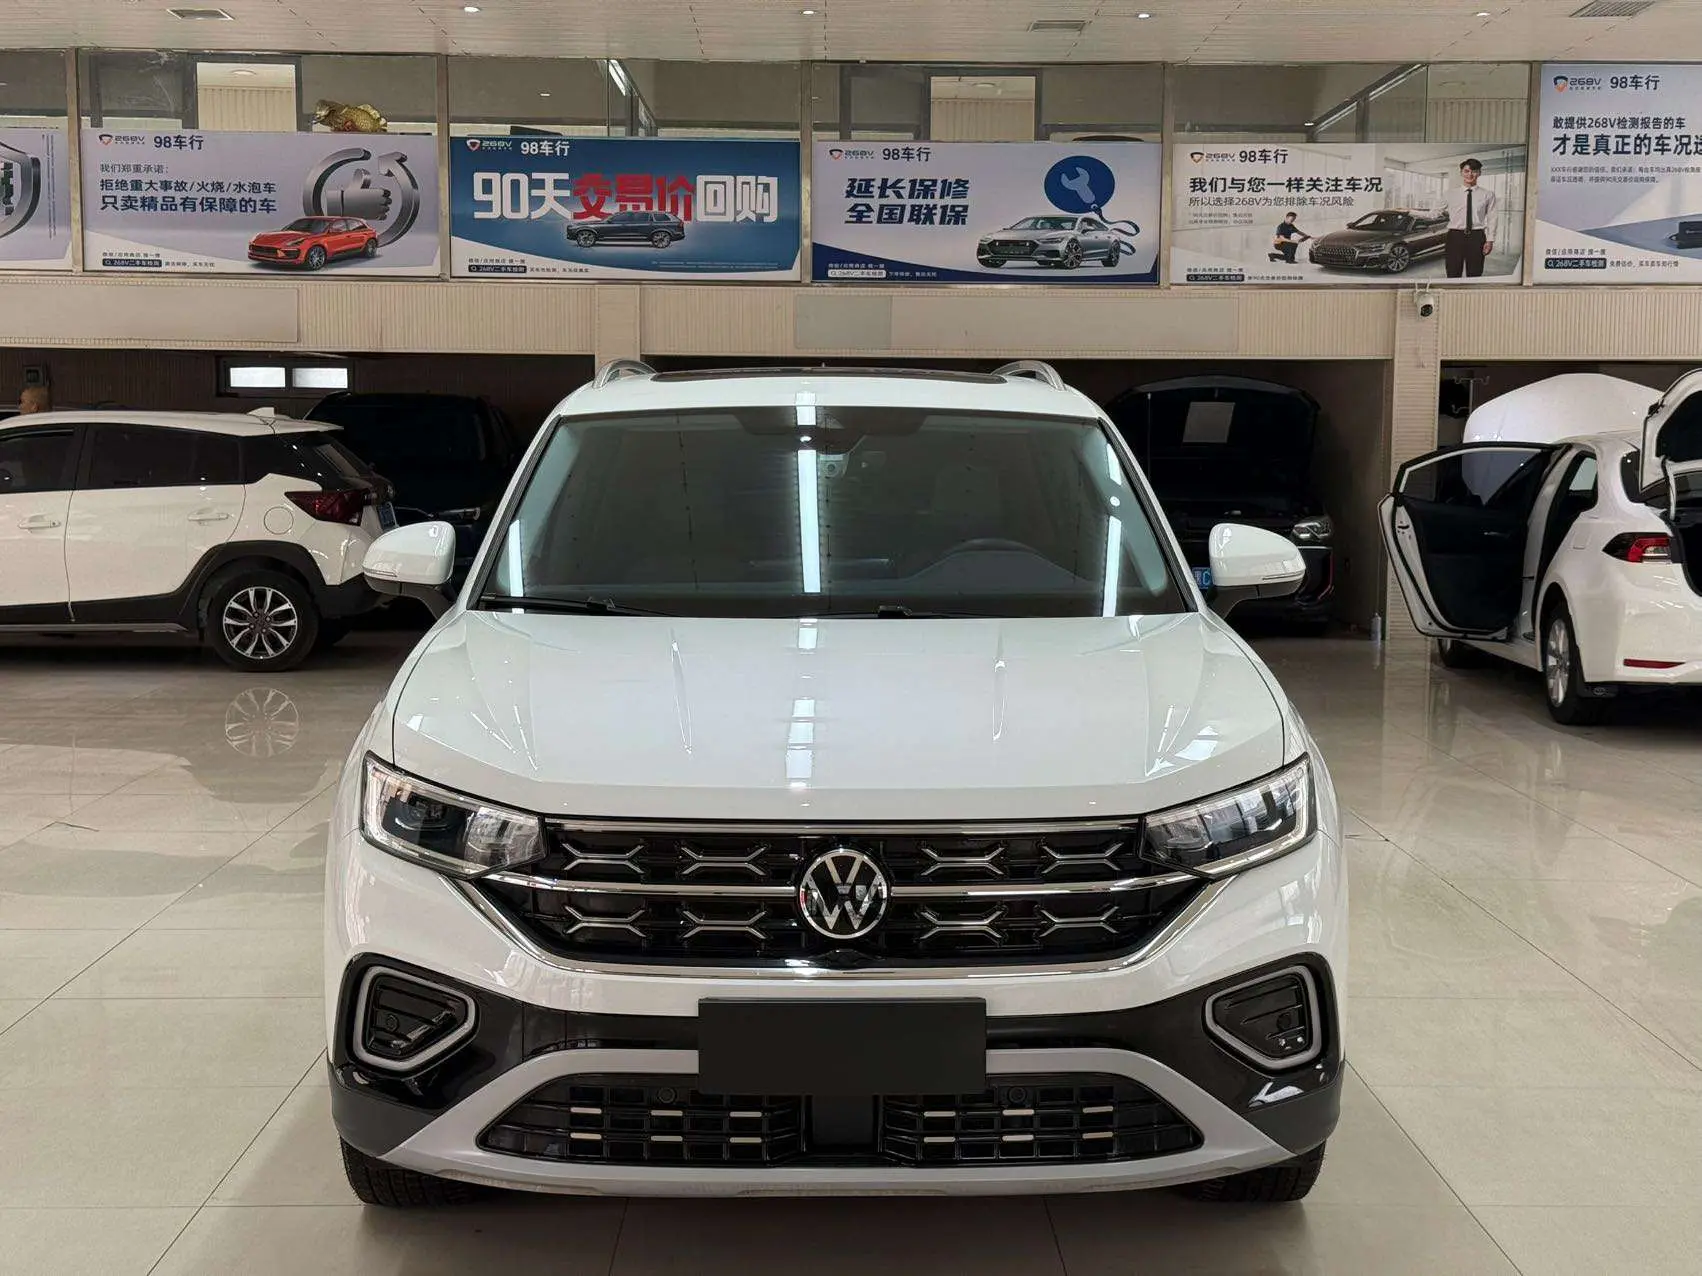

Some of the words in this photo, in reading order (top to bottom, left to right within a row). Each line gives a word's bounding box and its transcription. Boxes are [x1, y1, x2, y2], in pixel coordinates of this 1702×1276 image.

[1610, 74, 1660, 91] 98车行
[1552, 116, 1686, 130] 敢提供268V检测报告的车
[153, 134, 204, 150] 98车行
[520, 140, 570, 156] 98车行
[882, 147, 931, 162] 98车行
[1239, 149, 1288, 164] 98车行
[100, 179, 277, 194] 拒绝重大事故/火烧/水泡车
[845, 178, 970, 200] 延长保修
[1189, 176, 1384, 193] 我们与您一样关注车况
[100, 195, 277, 214] 只卖精品有保障的车
[472, 172, 779, 223] 90天交易价回购
[1188, 196, 1354, 207] 所以选择268V为您排除车况风险
[844, 203, 969, 226] 全国联保
